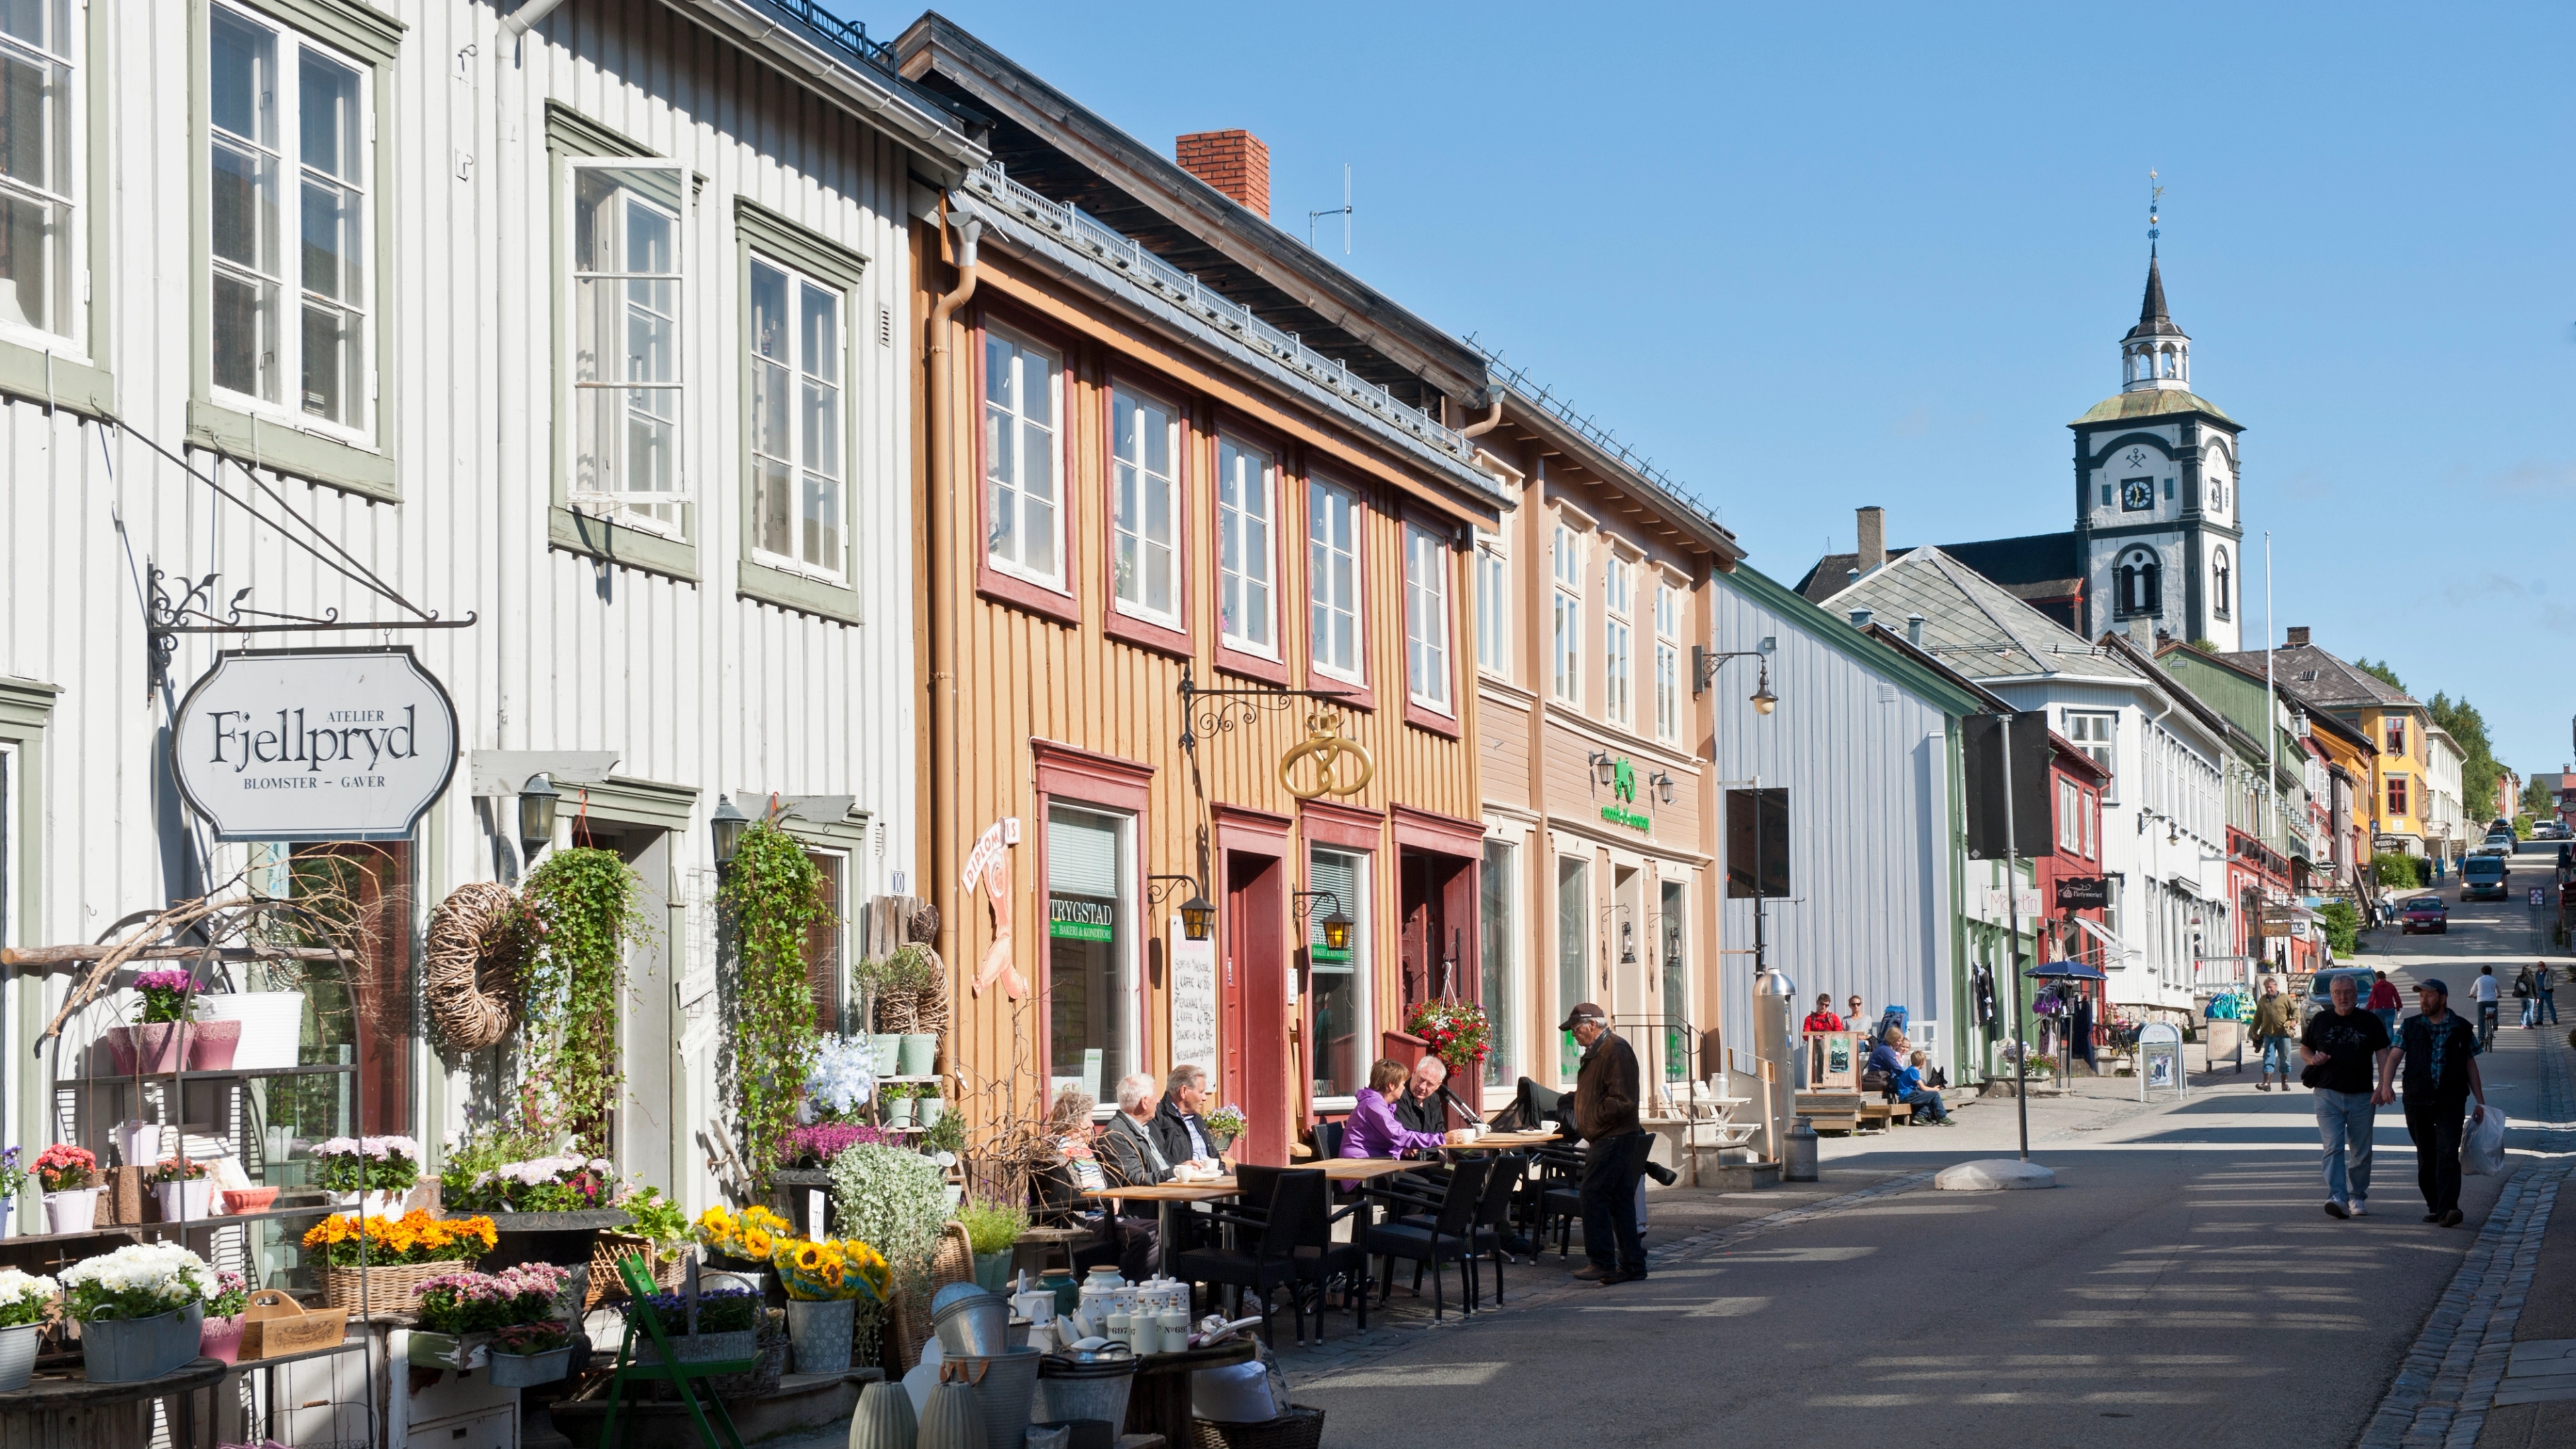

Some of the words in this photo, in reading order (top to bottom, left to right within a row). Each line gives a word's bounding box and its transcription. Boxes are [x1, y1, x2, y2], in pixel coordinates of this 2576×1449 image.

[327, 710, 385, 722] ATELIER
[207, 704, 419, 773] Fjellpryd
[244, 777, 318, 790] BLOMSTER
[341, 775, 386, 788] GAVER
[894, 873, 904, 892] 10
[1049, 899, 1112, 926] TRYGSTAD
[1059, 925, 1078, 936] BAKERI
[1078, 926, 1083, 936] &
[1083, 927, 1111, 939] KONDITORI
[1313, 947, 1327, 957] BAKERI
[1180, 975, 1194, 989] KAFFE
[1180, 1010, 1193, 1023] KAFFE
